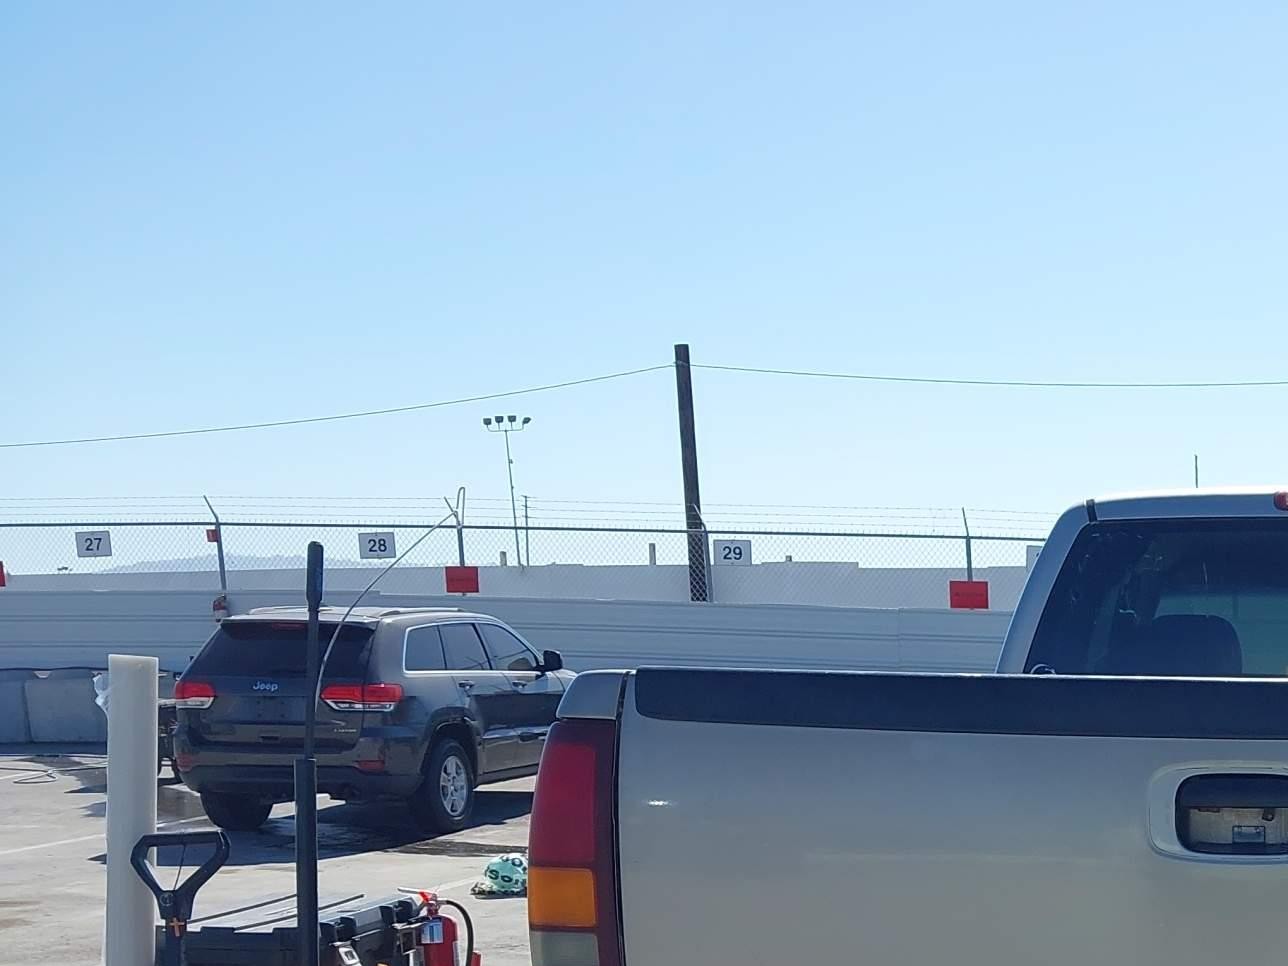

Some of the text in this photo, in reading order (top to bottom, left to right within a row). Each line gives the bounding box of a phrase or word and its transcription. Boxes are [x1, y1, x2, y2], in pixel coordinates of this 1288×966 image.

[84, 537, 103, 552] 27
[367, 538, 388, 553] 28
[722, 545, 743, 561] 29
[252, 680, 279, 692] Jeep
